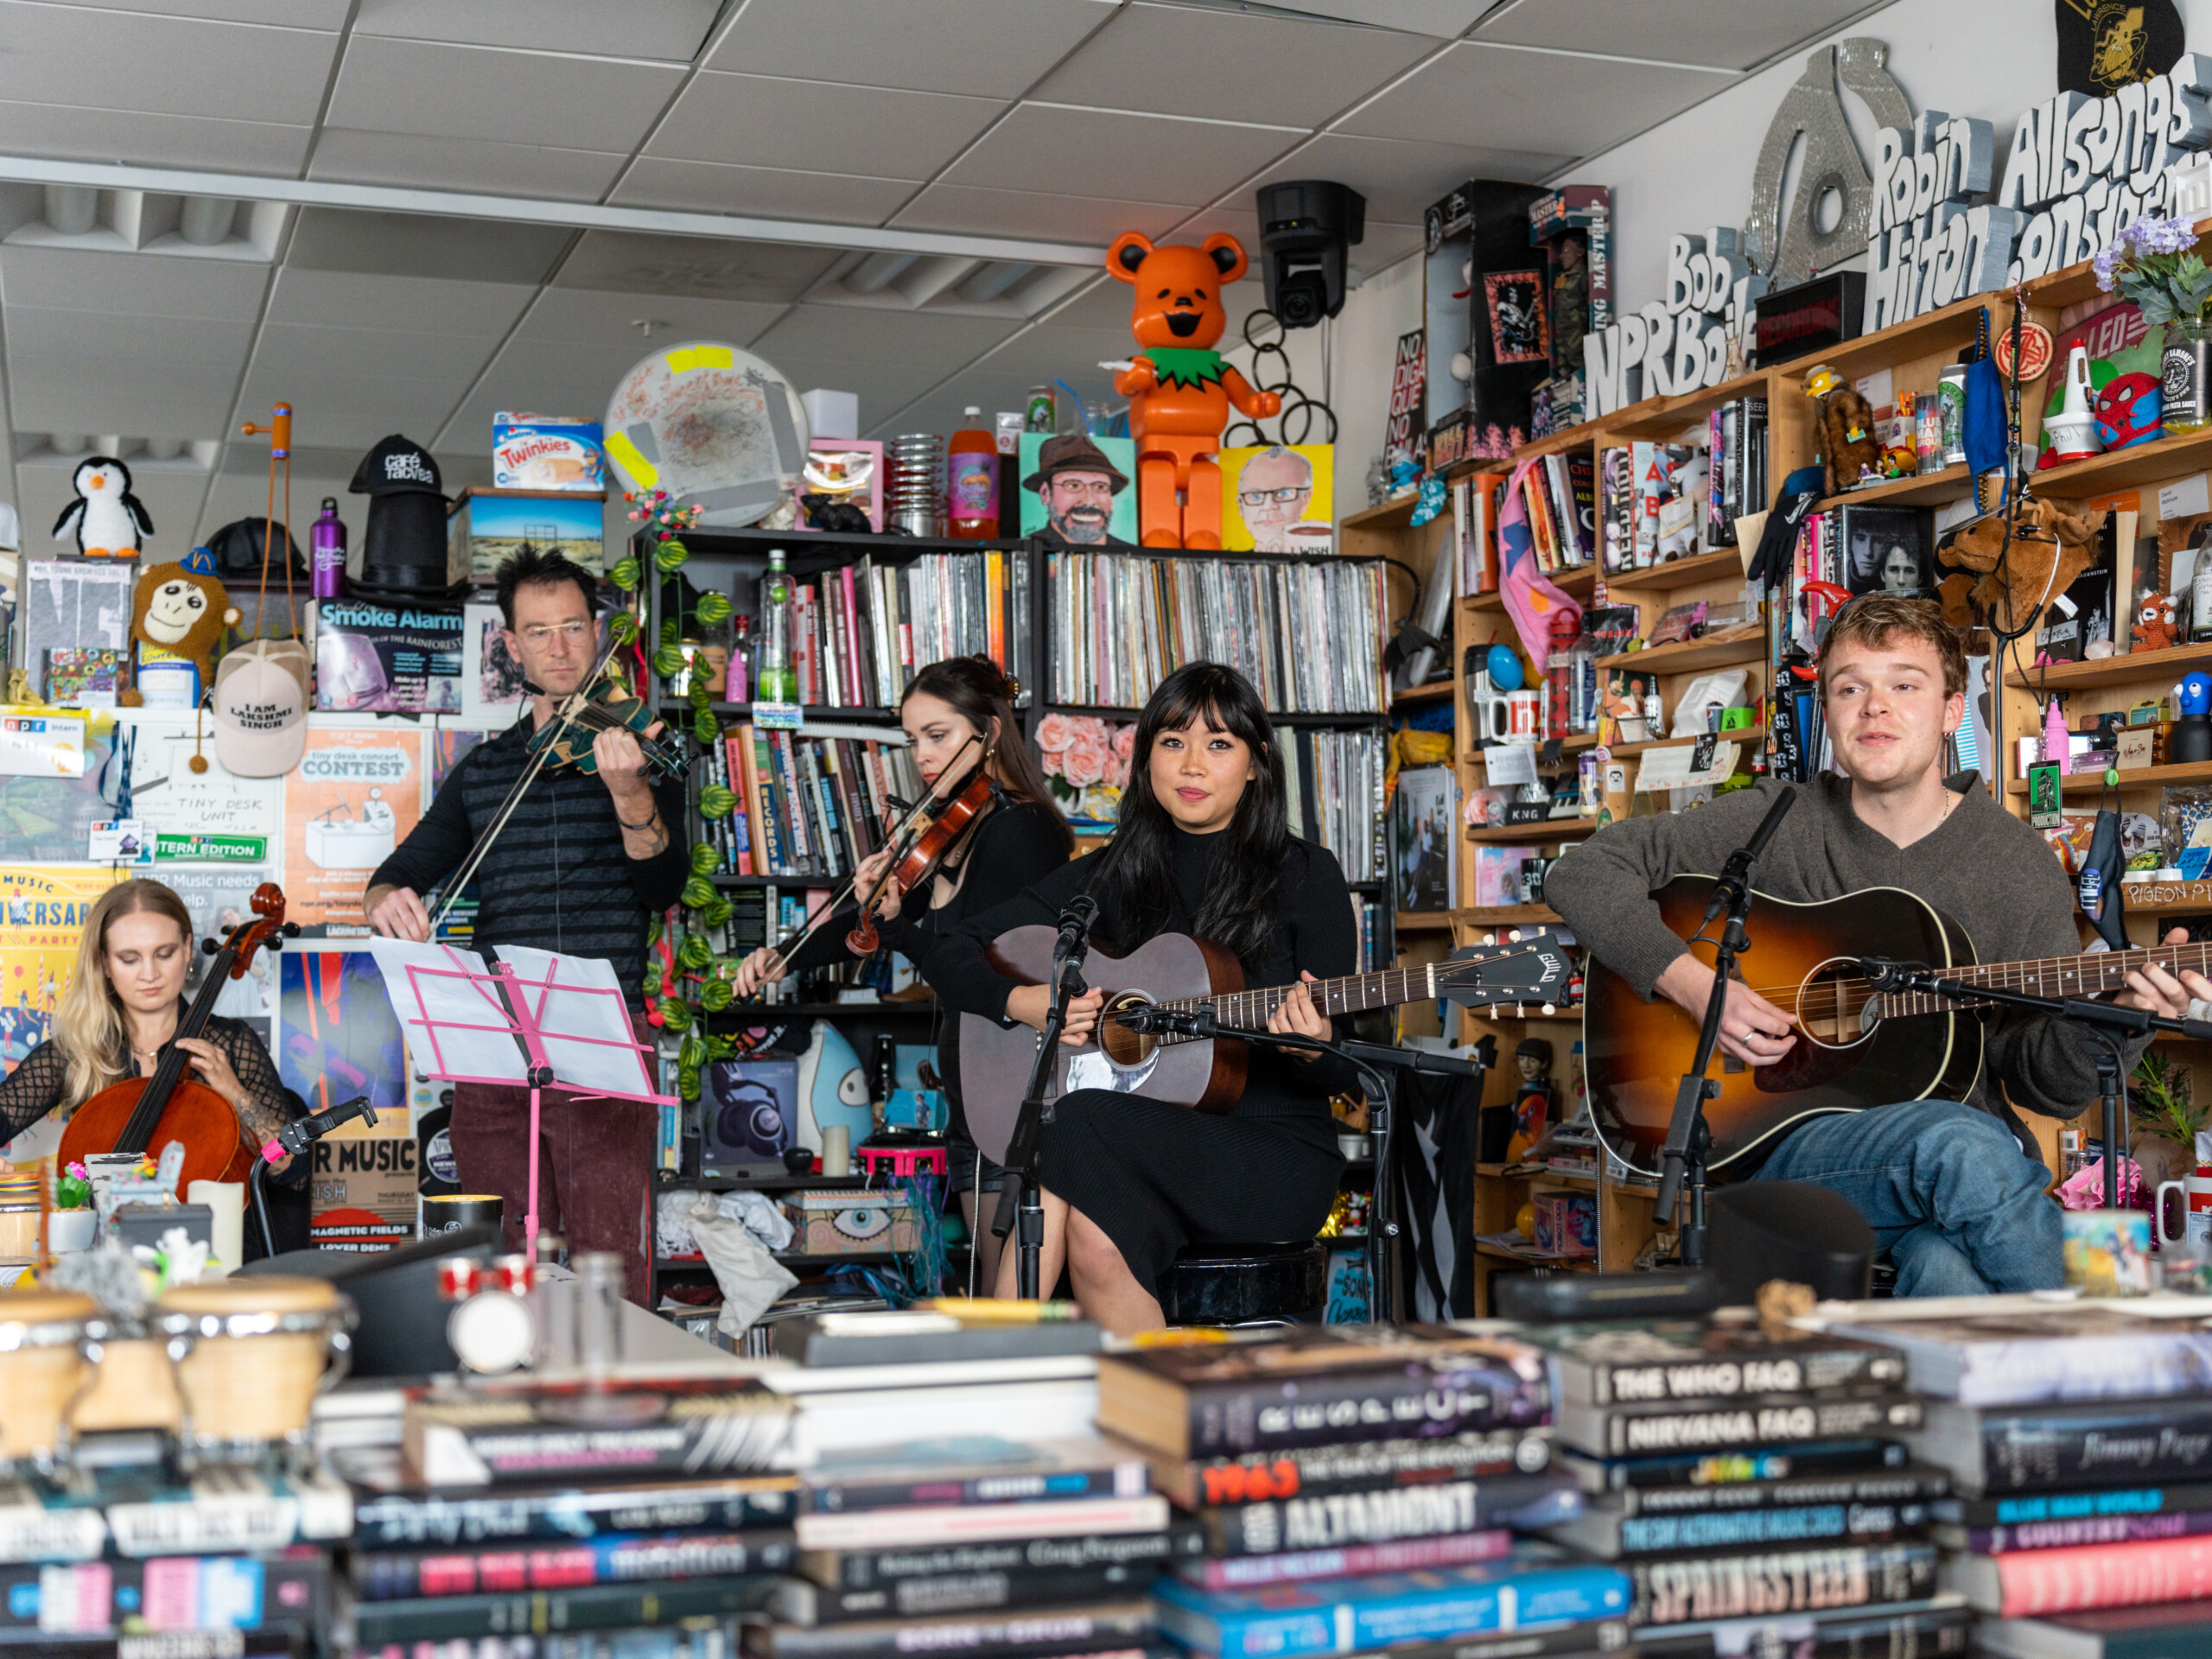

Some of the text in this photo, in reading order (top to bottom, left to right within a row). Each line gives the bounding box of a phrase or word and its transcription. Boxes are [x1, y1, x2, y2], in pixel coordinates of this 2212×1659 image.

[2090, 3, 2126, 32] LAWRENCE
[1870, 111, 1970, 235] Robin
[1592, 216, 1607, 289] MASTER
[1667, 226, 1732, 315] Bob
[1863, 205, 1991, 335] Hilton
[1397, 334, 1421, 365] NO
[1583, 302, 1675, 423] NPR
[1391, 384, 1422, 416] QUE
[1388, 414, 1410, 444] NO
[499, 437, 570, 468] Twinkies
[2161, 490, 2172, 499] David
[1300, 545, 1329, 555] WISH
[1834, 524, 1843, 557] DREAM
[321, 604, 397, 627] Smoke
[399, 609, 463, 630] Alarm
[406, 636, 463, 650] RAINFOREST
[1593, 628, 1632, 639] YESSIE
[231, 708, 293, 721] LAKSHMI
[253, 704, 276, 713] AM
[5, 720, 78, 733] npr Intern
[240, 720, 283, 729] SINGH
[303, 760, 404, 776] CONTEST
[312, 752, 332, 762] tiny
[334, 752, 358, 761] desk
[178, 798, 263, 810] TINY DESK
[201, 811, 237, 822] UNIT
[849, 792, 863, 823] FAMILY
[1512, 809, 1539, 820] KNG
[760, 787, 778, 858] RECORDS
[2031, 812, 2060, 828] PRODUCTION
[200, 842, 256, 855] EDITION
[3, 875, 54, 893] MUSIC
[174, 874, 213, 887] Music
[217, 874, 259, 887] needs
[2129, 883, 2187, 904] PIGEON
[182, 893, 208, 907] elp.
[29, 936, 79, 944] PARTY
[1537, 953, 1562, 983] GUILD
[339, 1140, 416, 1173] MUSIC
[311, 1225, 409, 1236] MAGNETIC FIELDS
[320, 1243, 391, 1253] LOWER DENS
[1612, 1367, 1665, 1400] THE
[1668, 1363, 1742, 1396] WHO
[1743, 1359, 1802, 1393] FAQ
[1259, 1388, 1491, 1433] RESPECT
[1627, 1407, 1816, 1449] NIRVANA FAQ
[2080, 1432, 2156, 1470] Jimmy
[2158, 1428, 2211, 1465] Page
[1287, 1482, 1478, 1548] ALTAMONT
[1027, 1535, 1171, 1567] Craig Ferguson
[1649, 1547, 1869, 1624] SPRINGSTEEN
